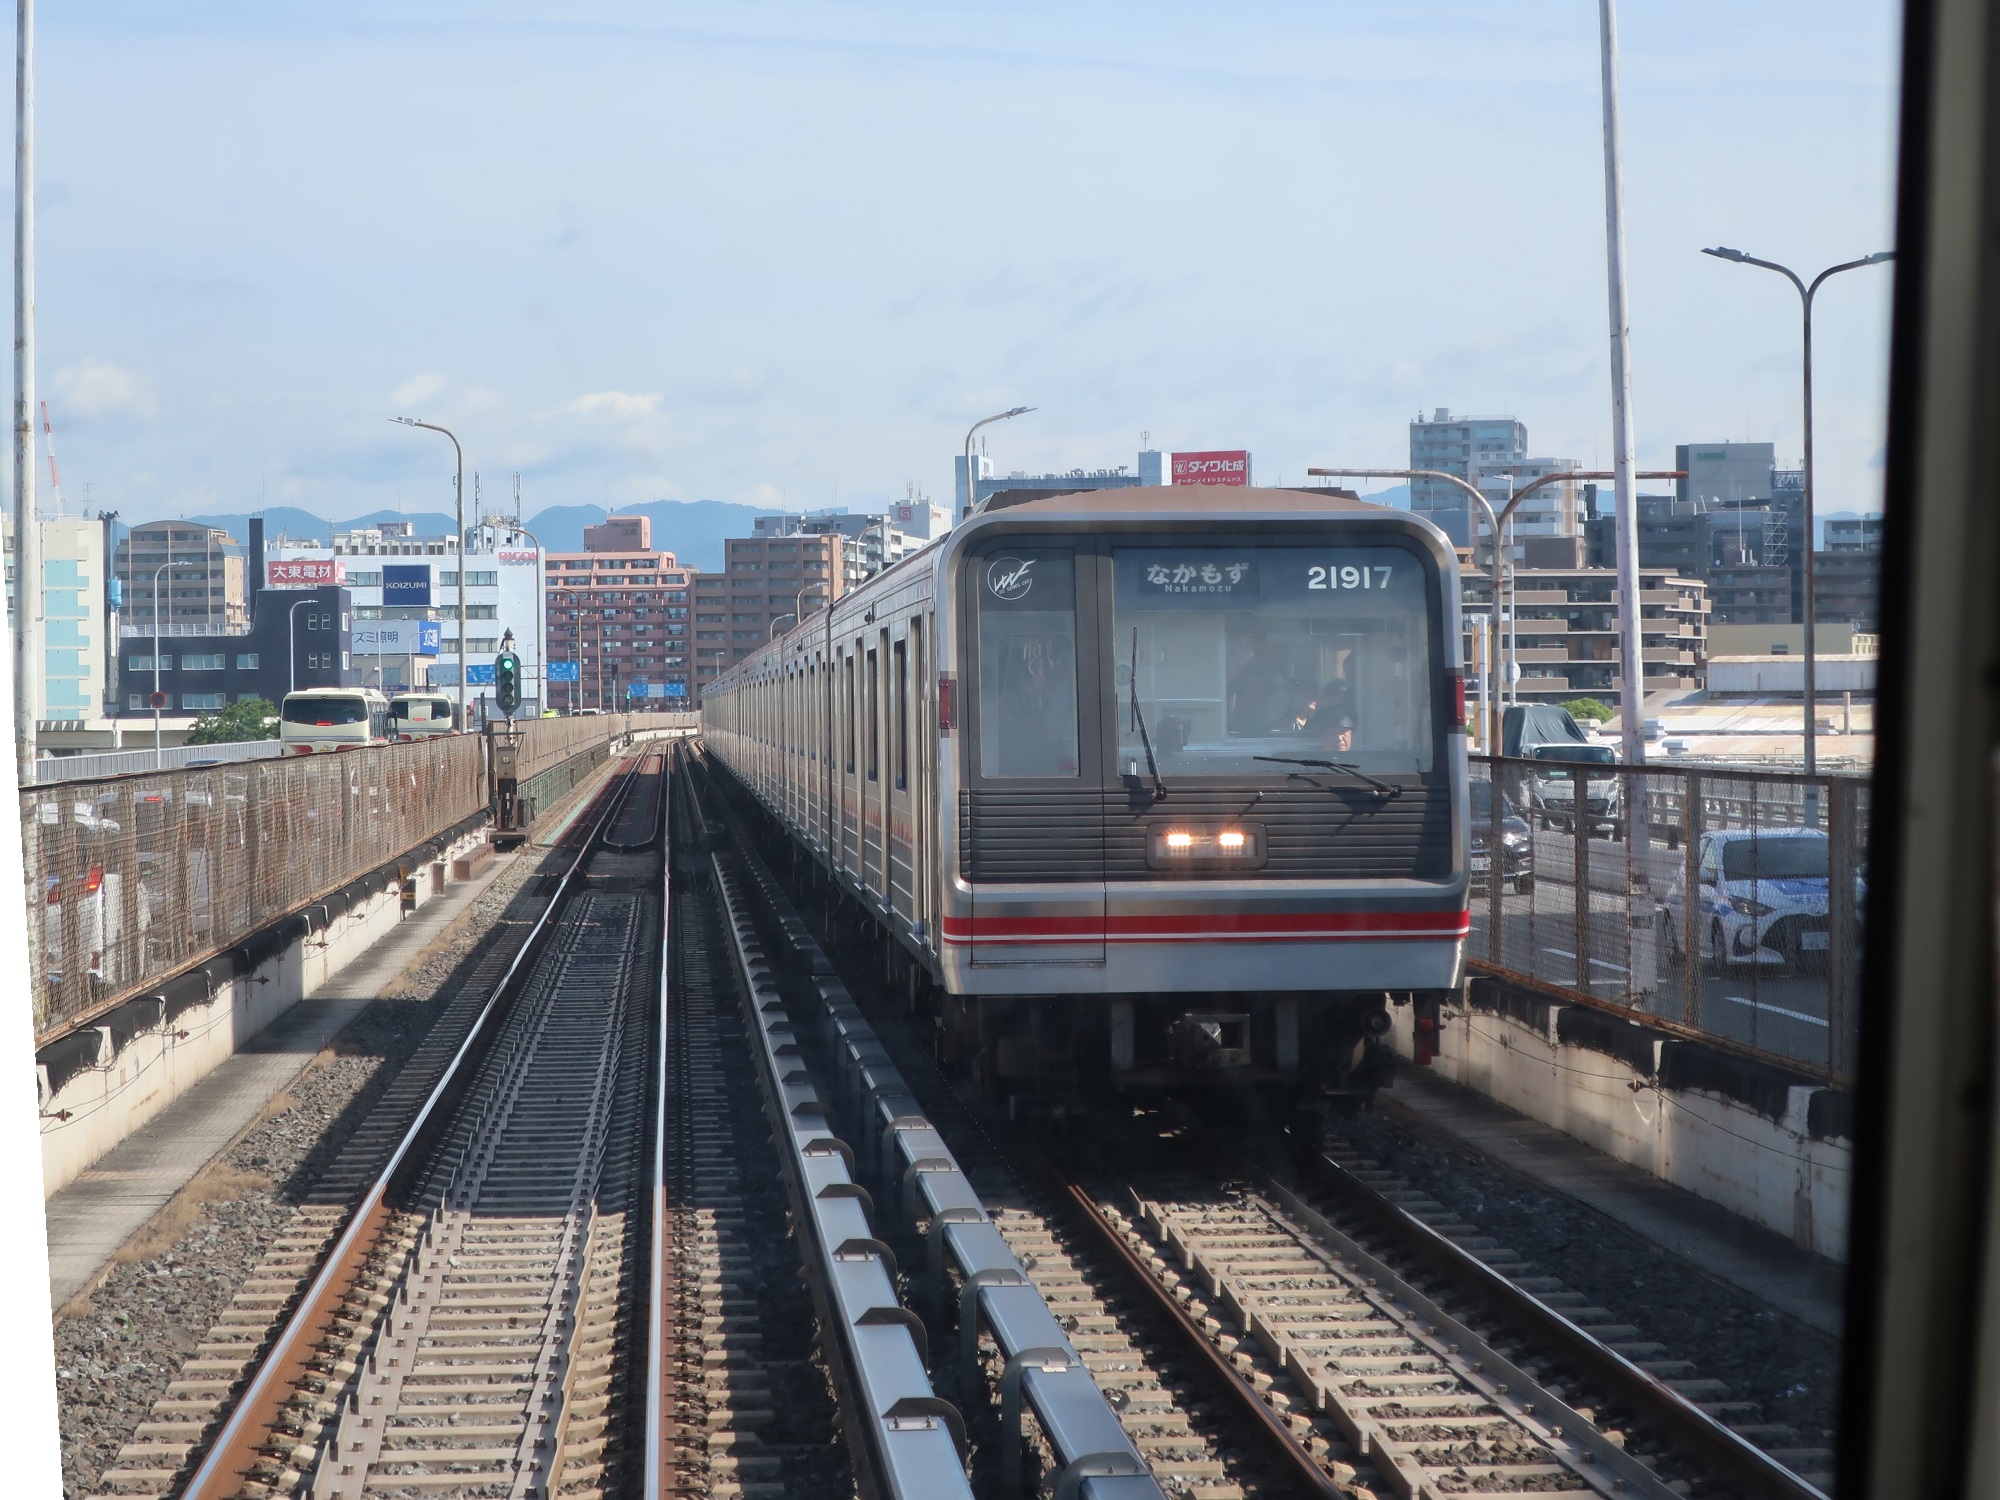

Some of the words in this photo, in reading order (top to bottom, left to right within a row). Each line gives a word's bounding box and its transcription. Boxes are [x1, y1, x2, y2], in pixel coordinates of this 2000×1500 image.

[1188, 460, 1244, 473] ダイワ化成
[272, 565, 332, 579] 大東電材
[1147, 563, 1250, 585] なかもず
[1308, 566, 1393, 589] 21917
[1165, 584, 1232, 593] Nakamozu
[352, 631, 399, 643] ズミ照明
